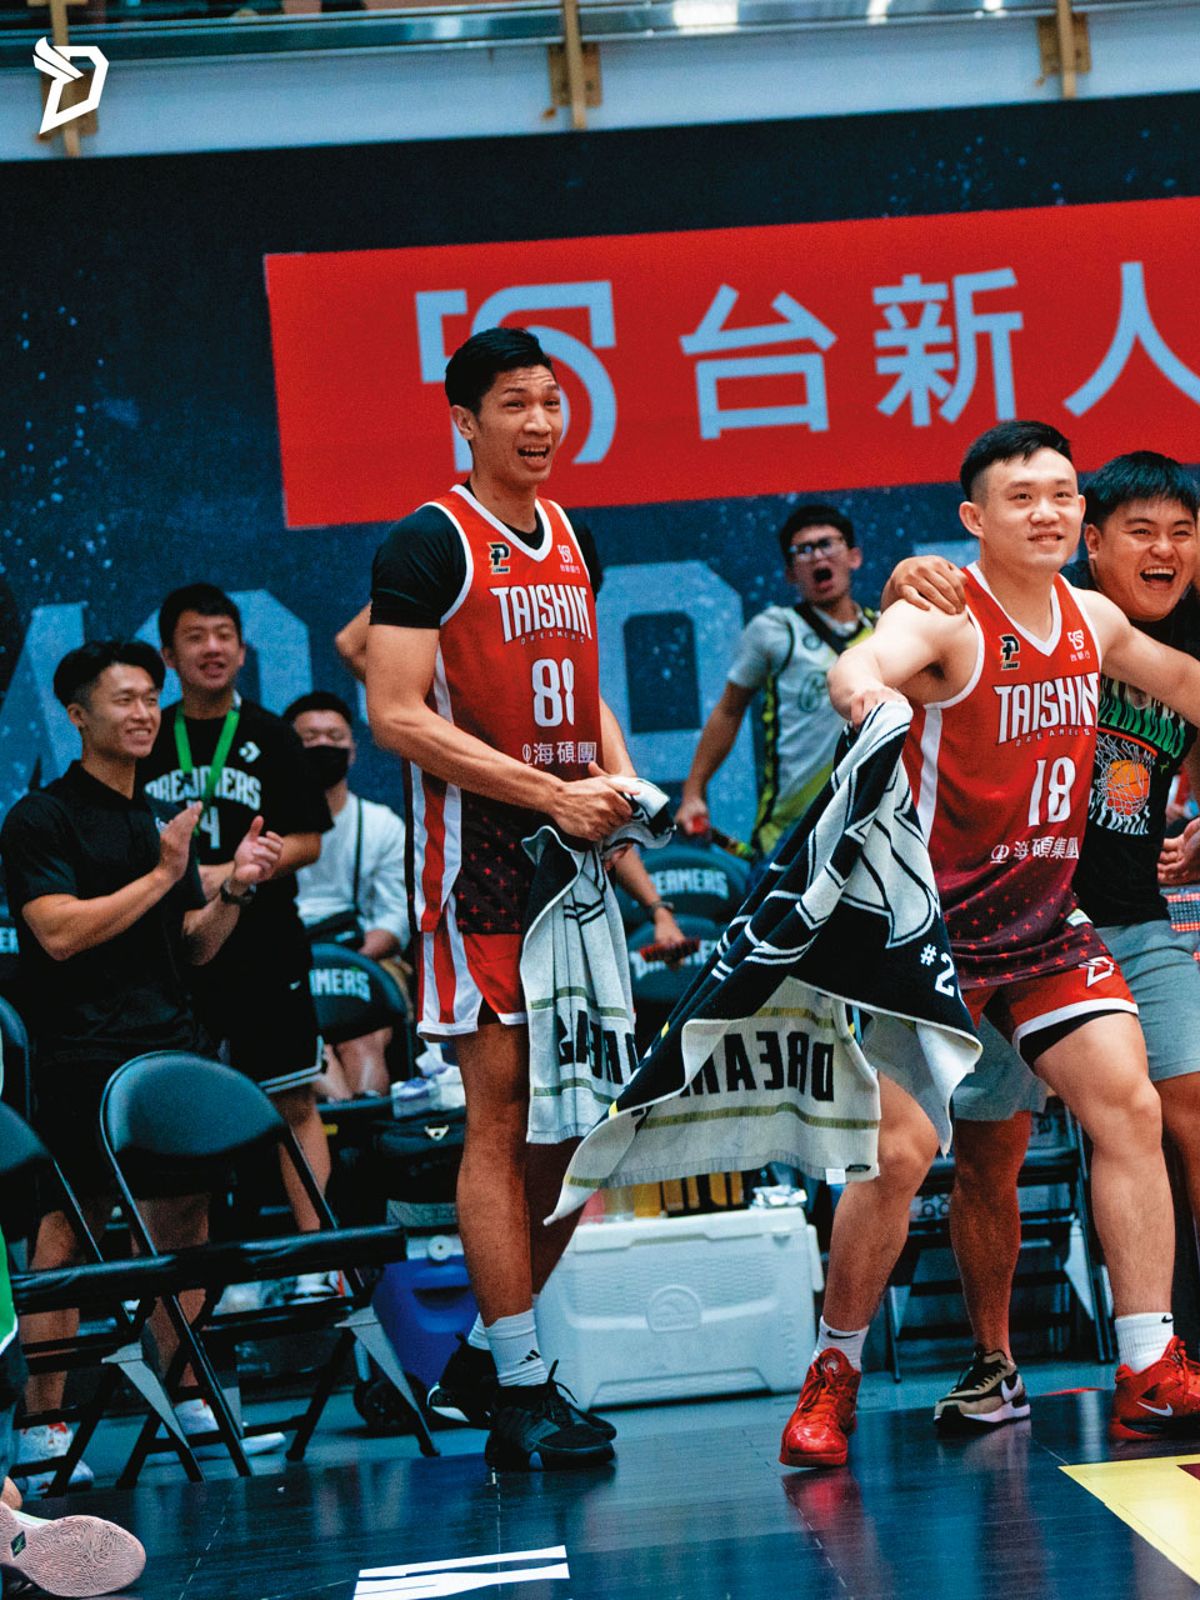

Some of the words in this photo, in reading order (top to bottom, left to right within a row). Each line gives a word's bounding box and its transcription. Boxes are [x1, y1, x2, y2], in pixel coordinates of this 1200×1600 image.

[488, 584, 594, 645] TAISHIN
[993, 671, 1099, 746] TAISHIN
[145, 765, 262, 811] DREERS
[1028, 755, 1076, 828] 18
